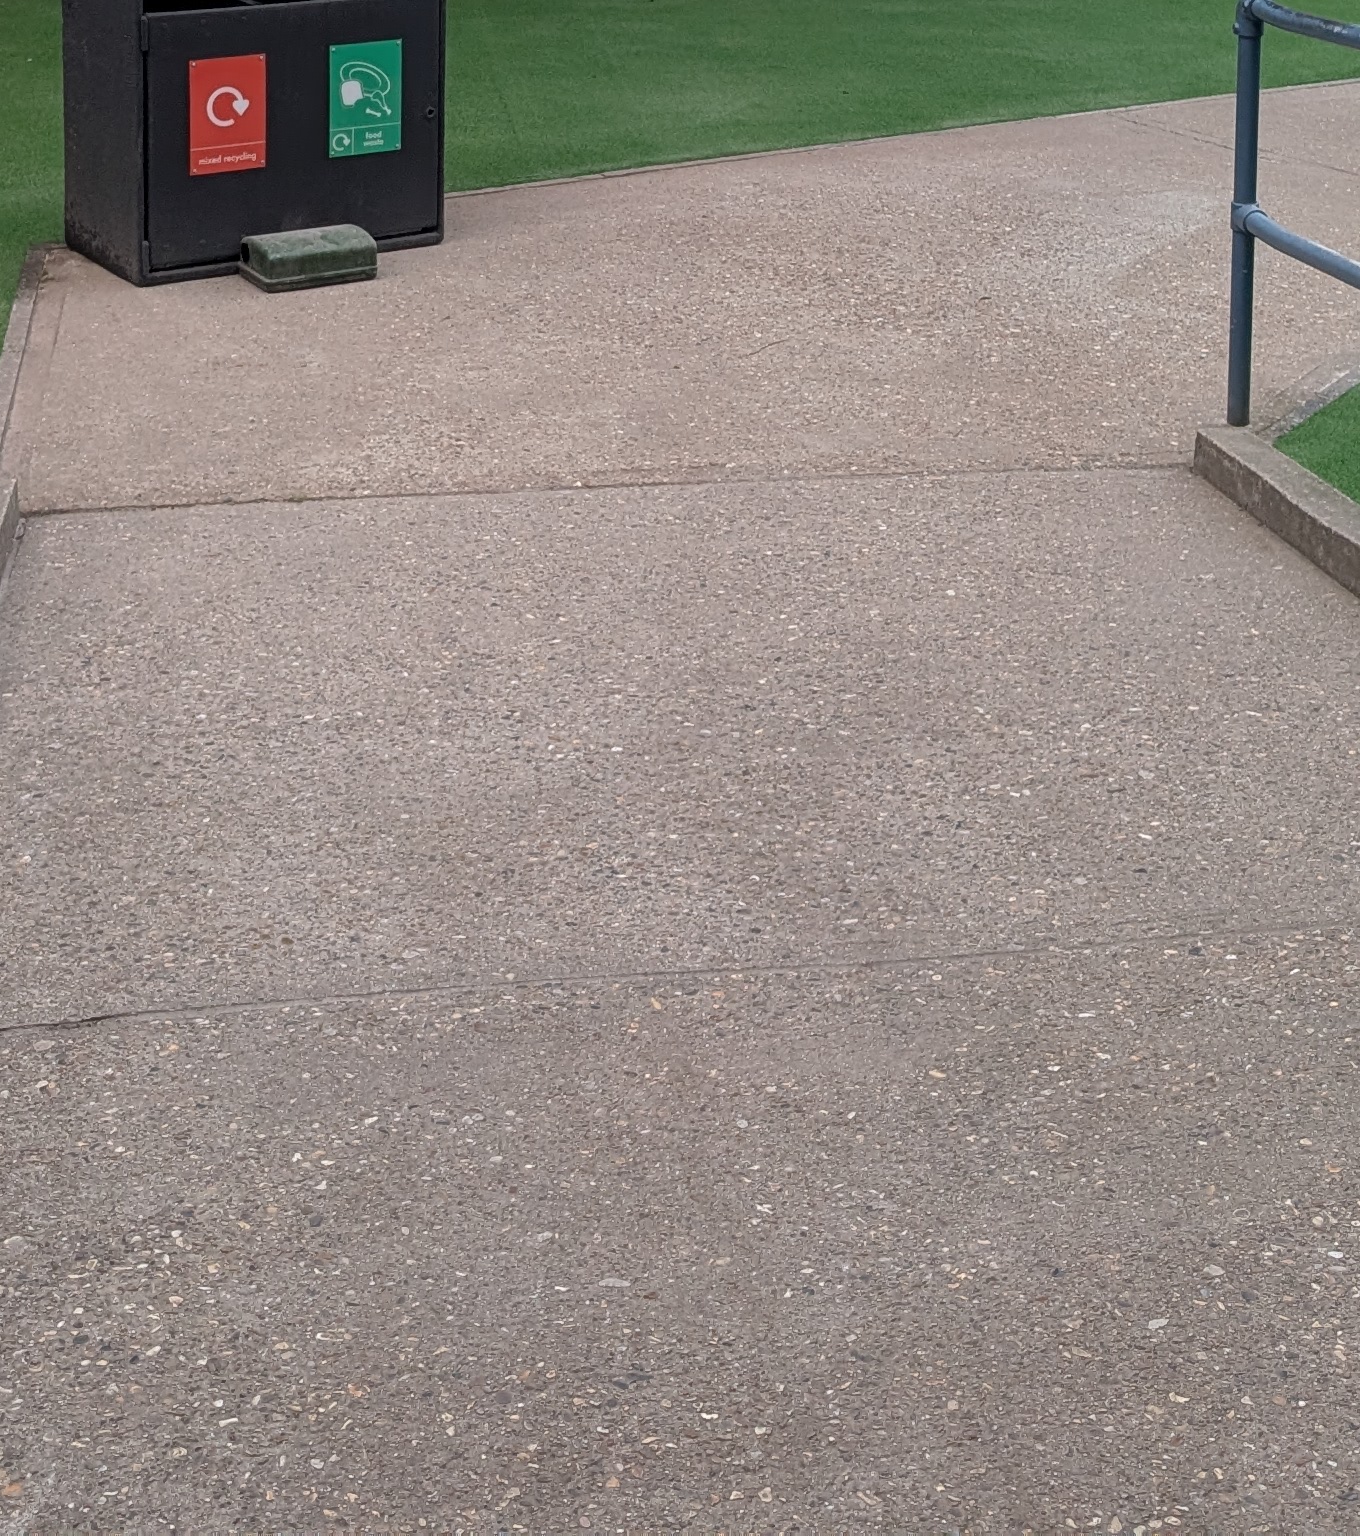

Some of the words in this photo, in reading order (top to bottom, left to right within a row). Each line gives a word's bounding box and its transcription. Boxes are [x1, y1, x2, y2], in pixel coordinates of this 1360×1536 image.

[365, 130, 382, 139] food
[198, 154, 222, 166] mixed
[223, 151, 257, 164] recycling
